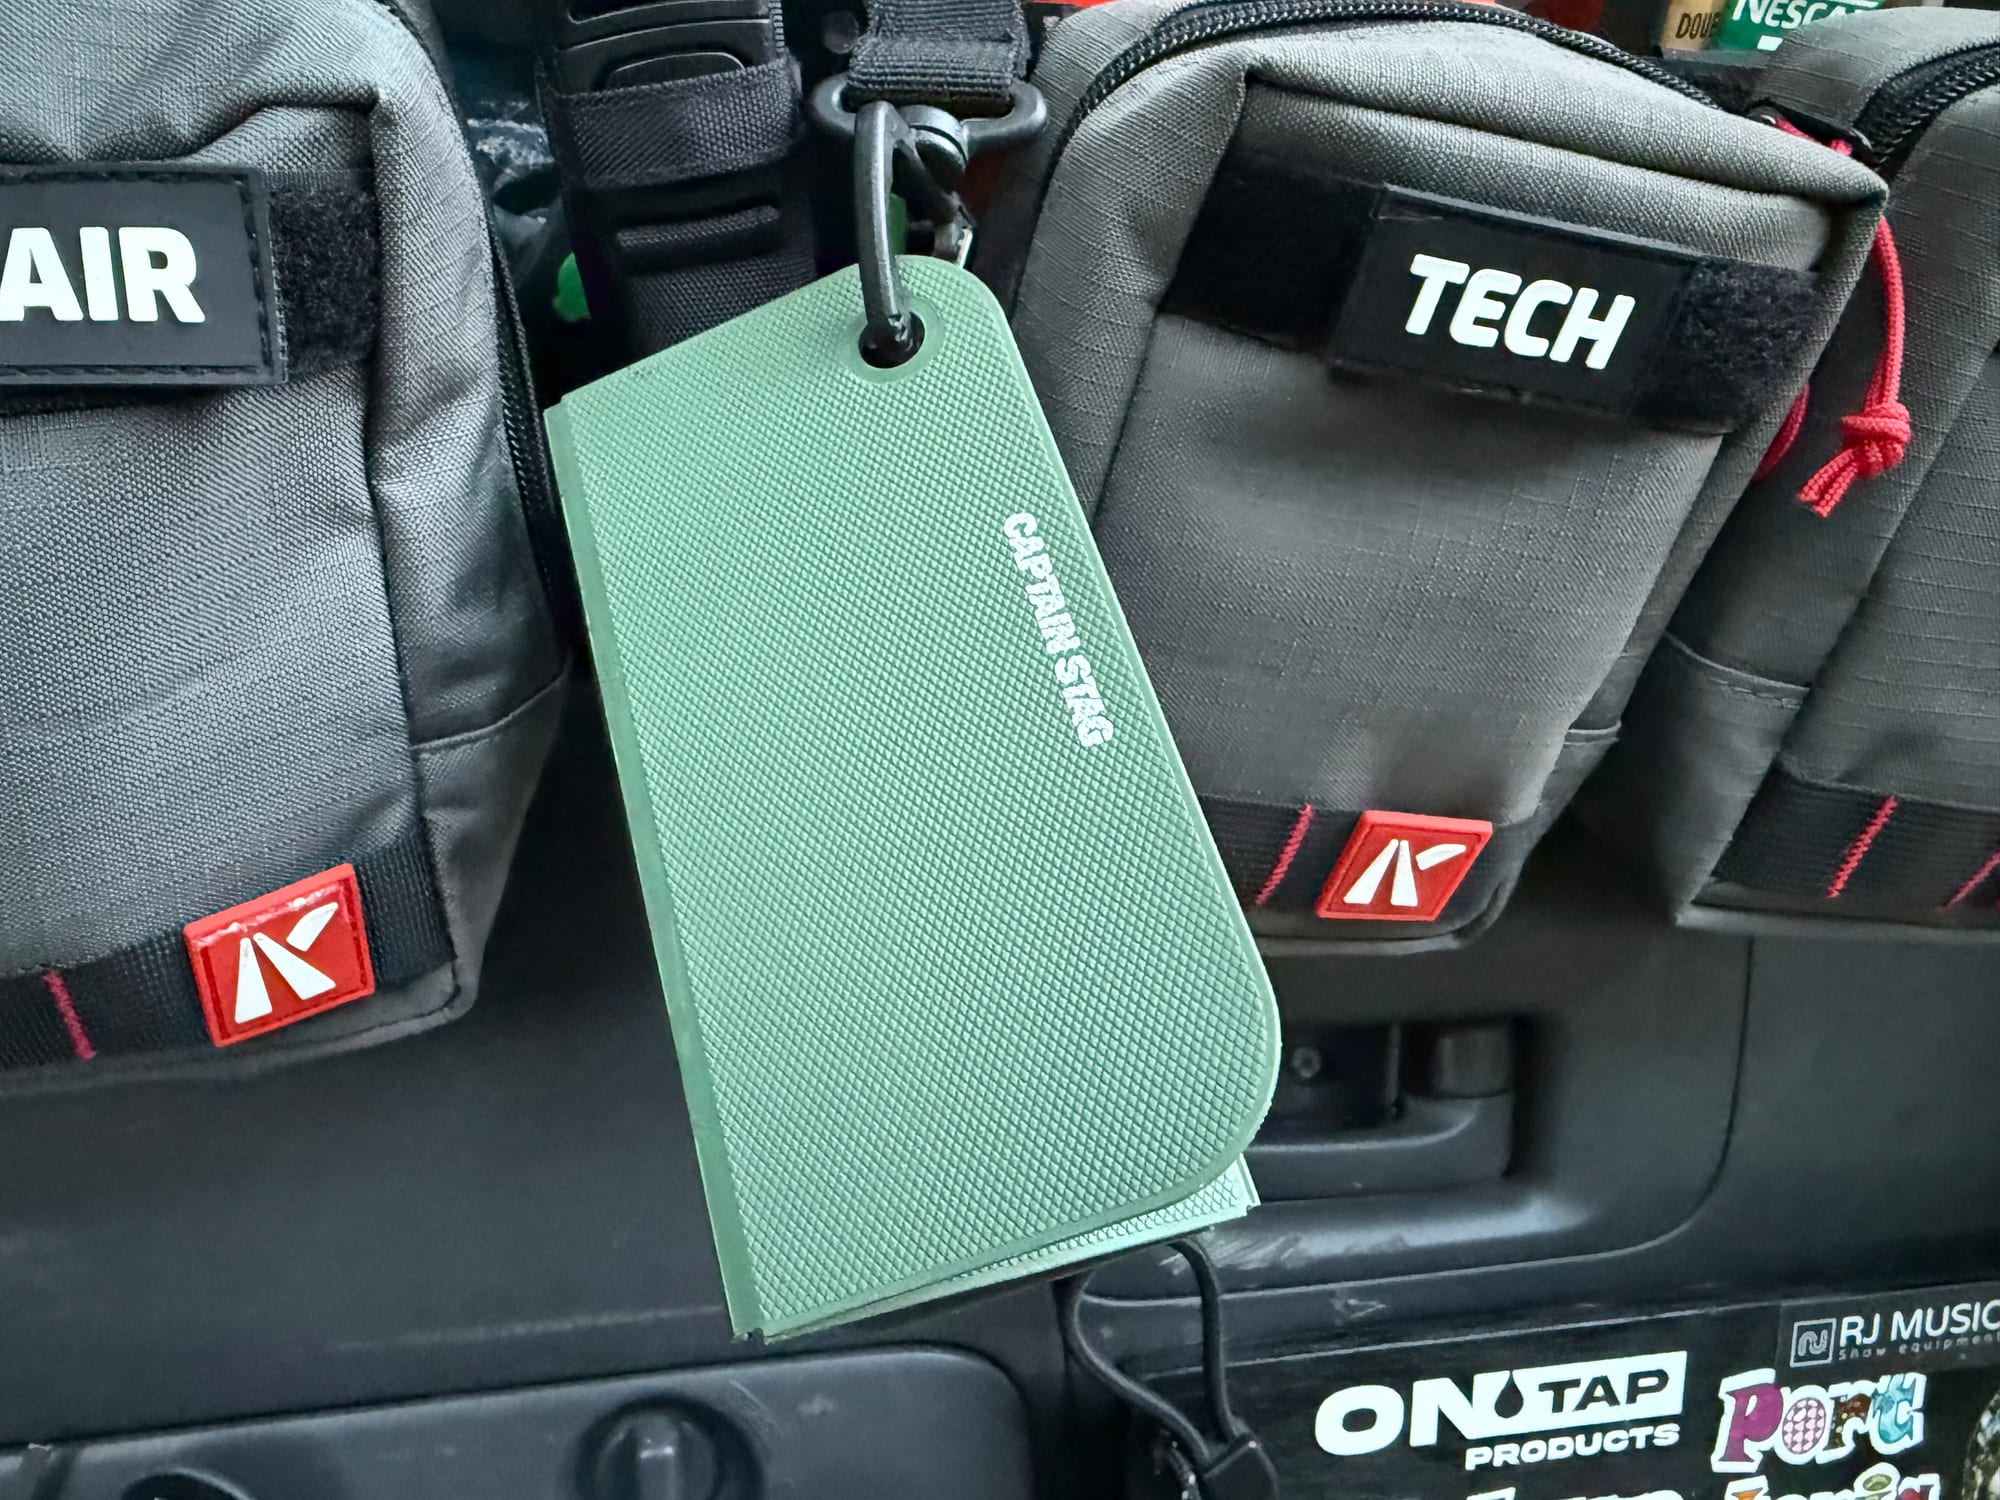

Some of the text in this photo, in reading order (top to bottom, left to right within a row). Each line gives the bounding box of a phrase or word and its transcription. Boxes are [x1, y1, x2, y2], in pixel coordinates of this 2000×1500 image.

[1732, 0, 1868, 29] NESC
[0, 226, 206, 323] AIR
[1405, 253, 1636, 369] TECH
[1003, 512, 1114, 748] CAPTAIN STAG
[1838, 1346, 1887, 1361] show
[1839, 1299, 2000, 1348] RJ MUSIC
[1315, 1368, 1670, 1456] ON TAP
[1465, 1423, 1680, 1471] PRODUCTS
